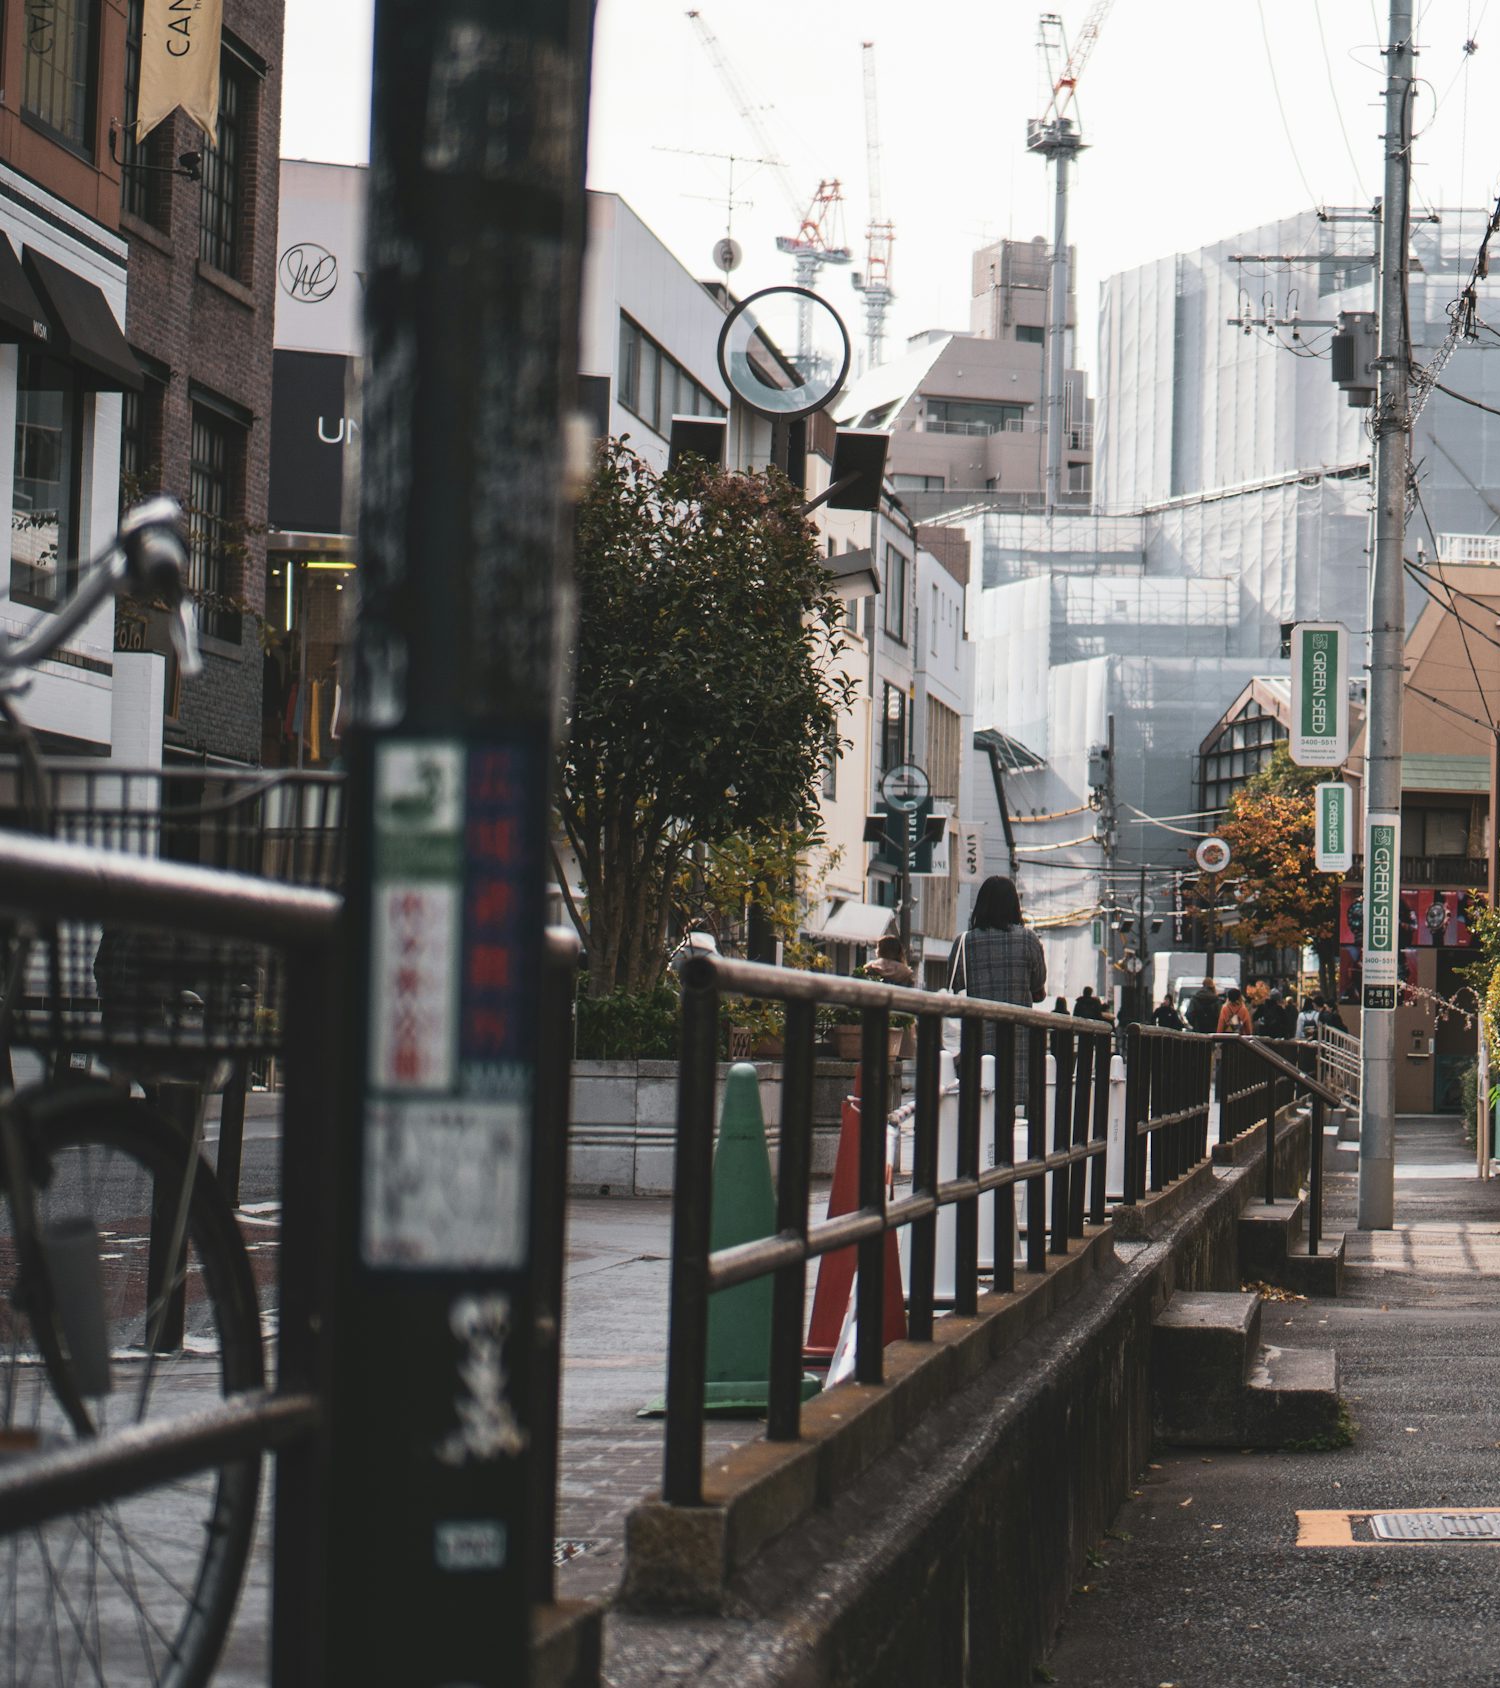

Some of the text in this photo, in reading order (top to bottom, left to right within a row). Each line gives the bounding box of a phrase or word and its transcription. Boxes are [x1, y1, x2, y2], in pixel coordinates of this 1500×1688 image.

[1312, 651, 1327, 734] GREEN SEED
[1329, 800, 1338, 829] GREEN
[1329, 830, 1338, 852] SEED
[1372, 848, 1390, 948] GREEN SEED
